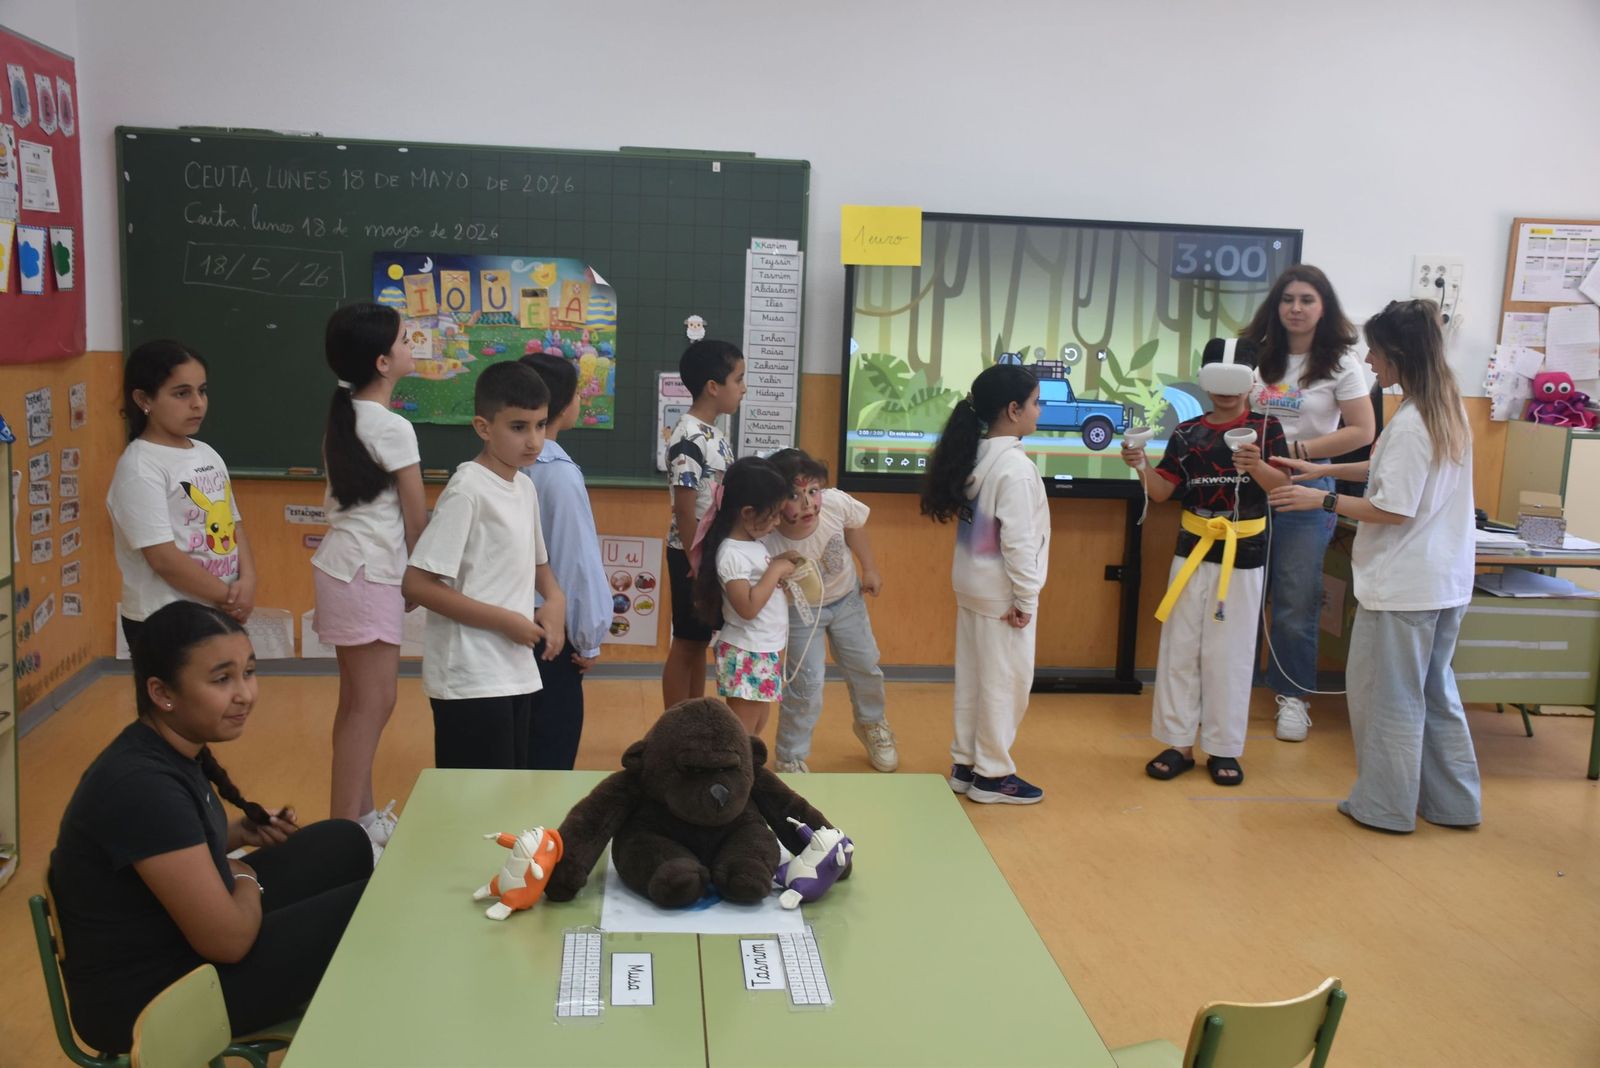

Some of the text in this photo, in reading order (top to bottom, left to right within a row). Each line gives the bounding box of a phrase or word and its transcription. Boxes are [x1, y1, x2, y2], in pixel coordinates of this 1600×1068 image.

[184, 160, 575, 194] CEUTA, LUNES 18 DE MAYO DE 2026
[252, 203, 295, 234] lunes
[302, 215, 326, 237] 18
[364, 222, 423, 249] mayo
[430, 222, 448, 240] de
[452, 223, 500, 241] 2026
[761, 240, 787, 249] Karim
[868, 234, 910, 246] euro
[1175, 242, 1268, 278] 3:00
[760, 271, 791, 280] Tasnim
[413, 286, 582, 326] I O U E A
[762, 313, 785, 322] Musa
[607, 543, 639, 563] U u
[628, 964, 645, 990] Musa
[746, 943, 771, 987] Tasnim
